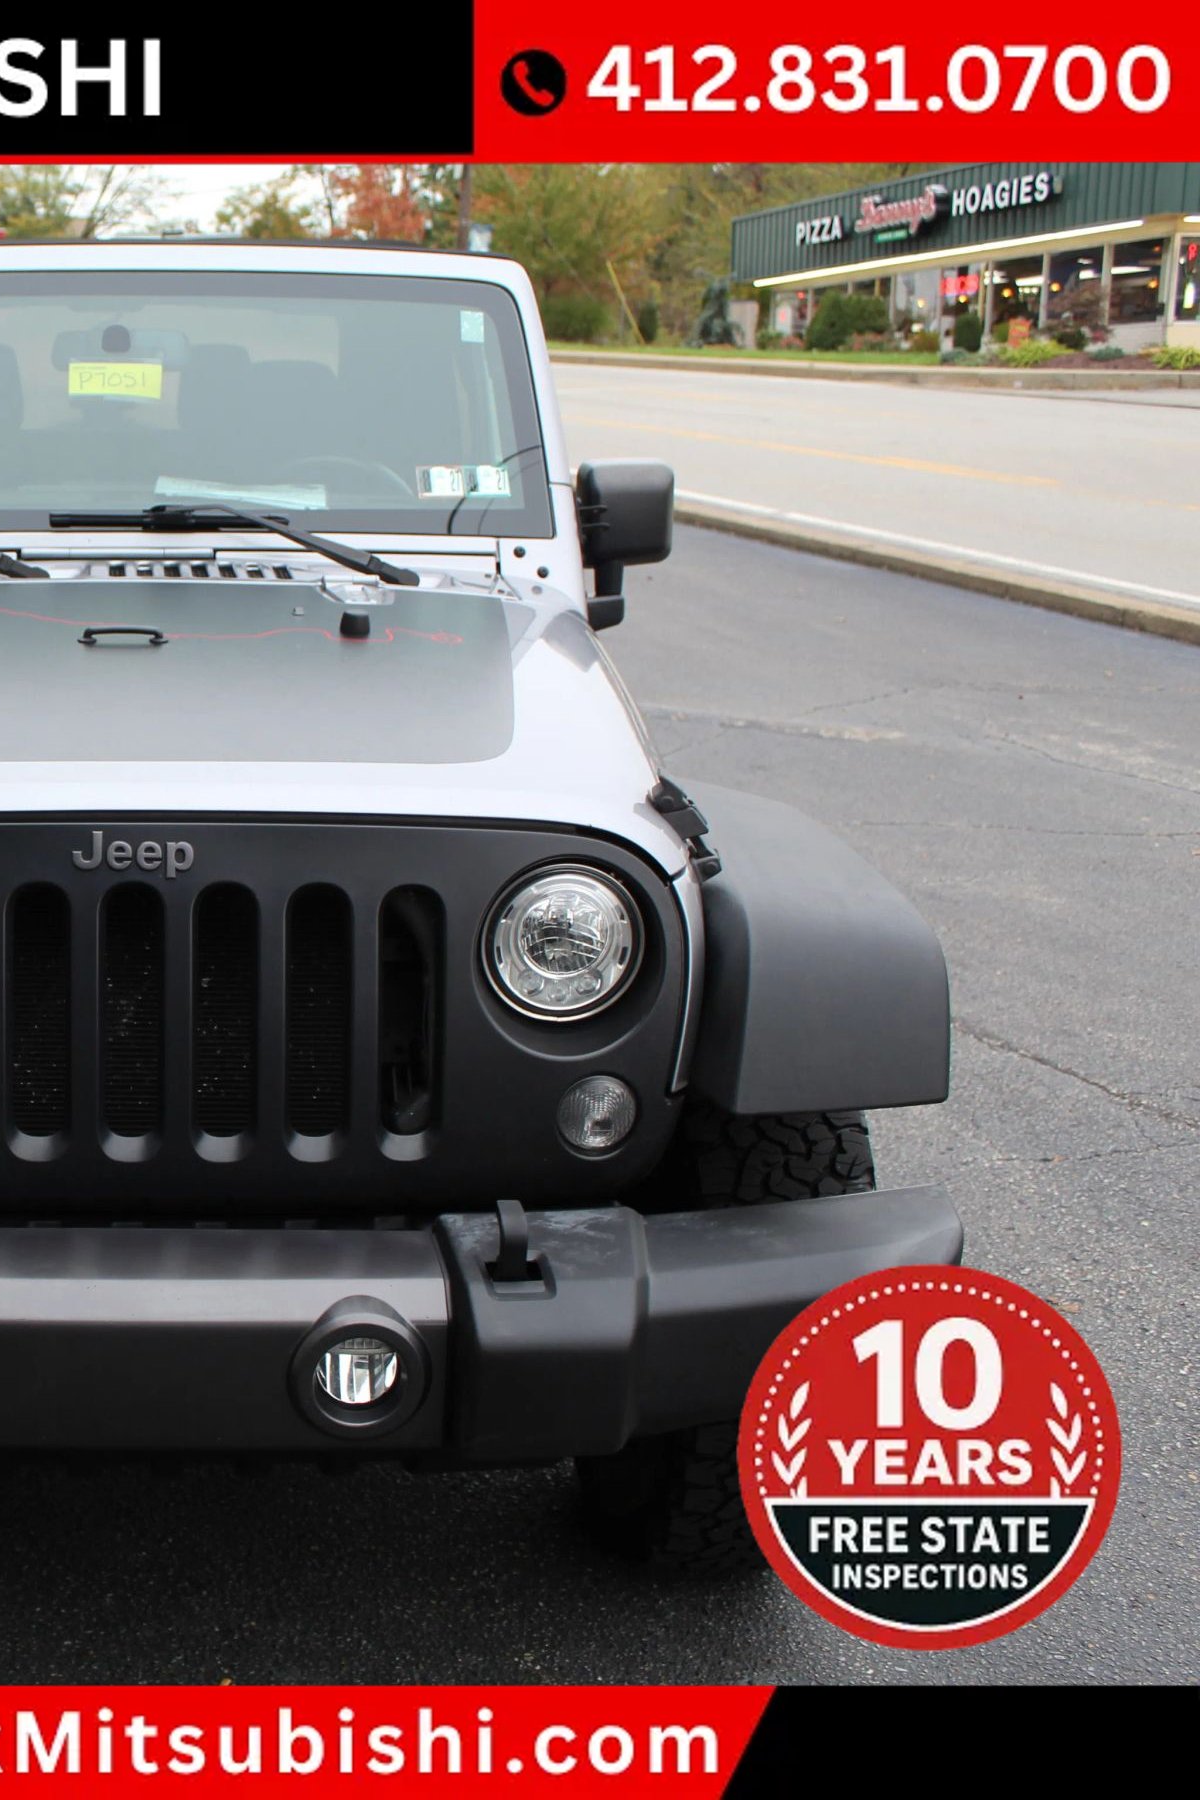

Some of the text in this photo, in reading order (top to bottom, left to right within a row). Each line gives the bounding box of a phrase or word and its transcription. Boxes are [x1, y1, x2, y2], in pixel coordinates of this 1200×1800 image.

[796, 214, 843, 247] PIZZA
[951, 171, 1050, 217] HOAGIES
[72, 830, 194, 878] Jeep
